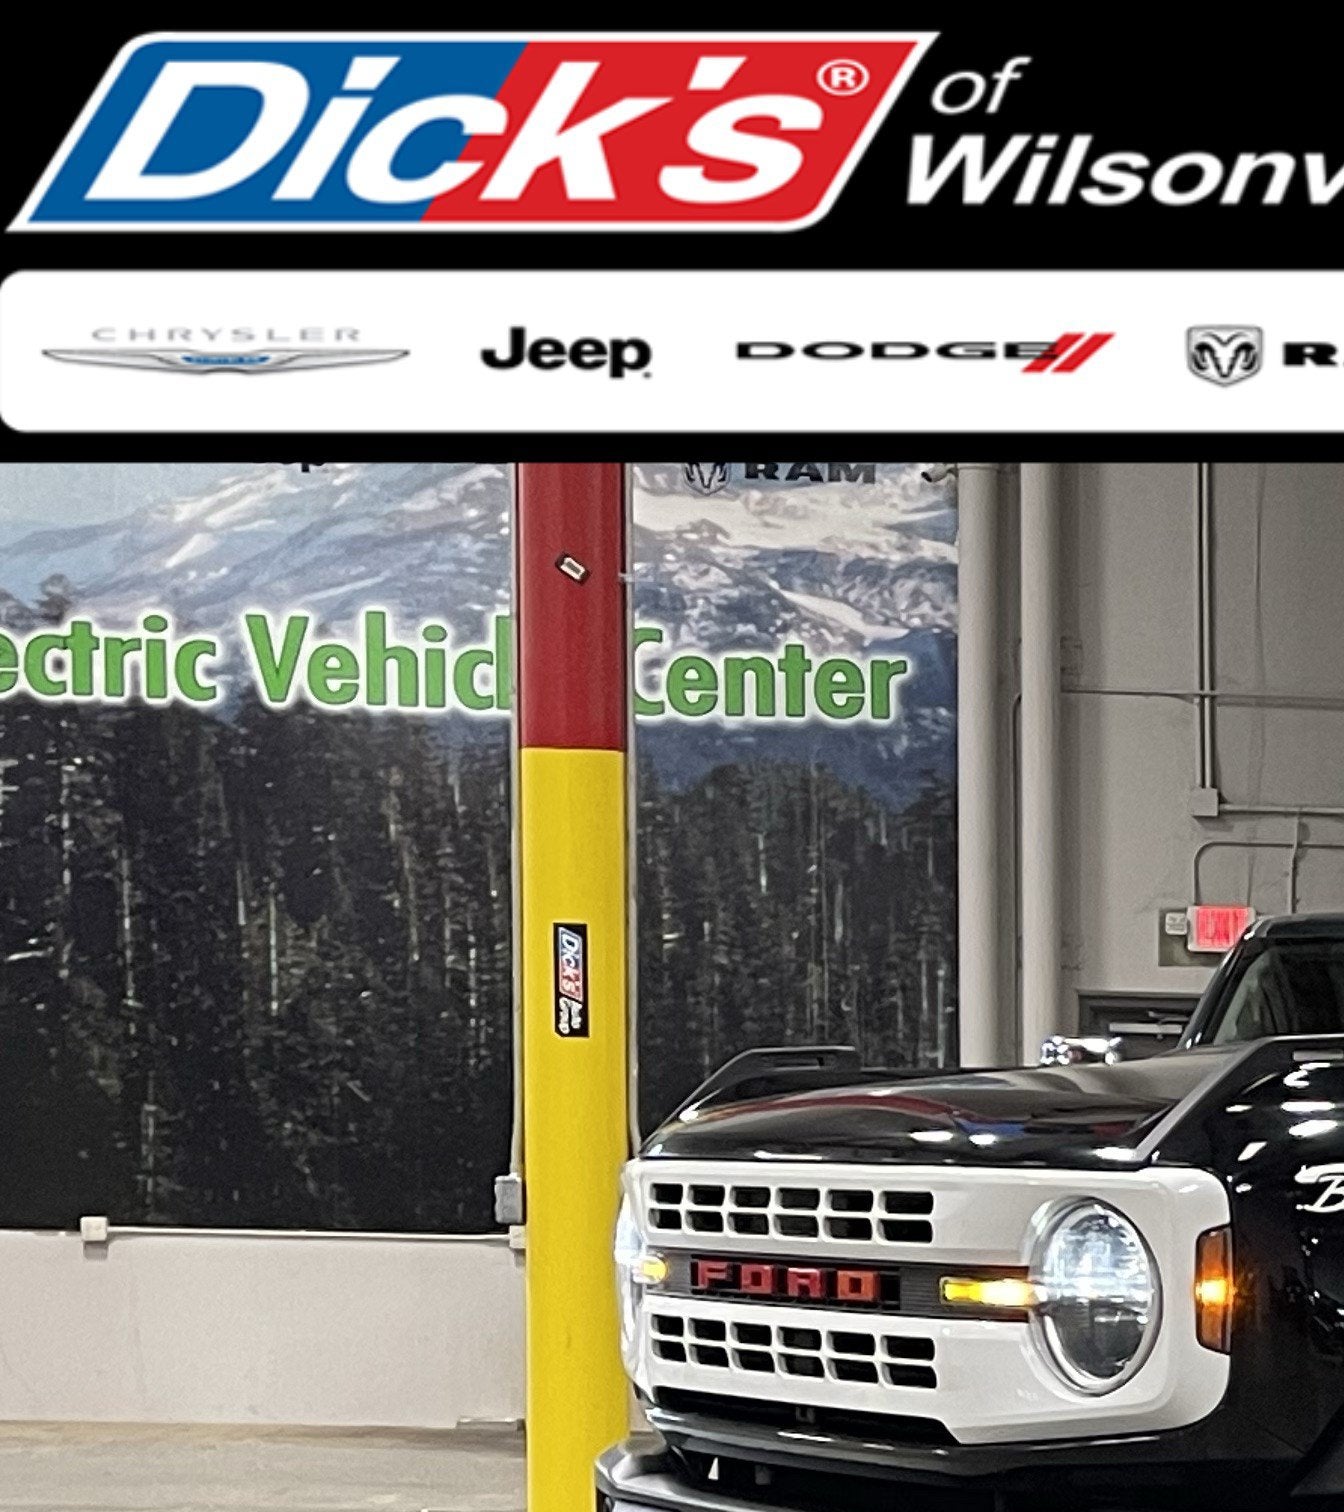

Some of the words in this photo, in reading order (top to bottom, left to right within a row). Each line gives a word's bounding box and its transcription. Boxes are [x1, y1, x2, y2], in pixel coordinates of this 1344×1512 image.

[744, 462, 876, 484] RAM
[245, 611, 511, 711] Vehicl
[697, 1258, 878, 1302] FORD
